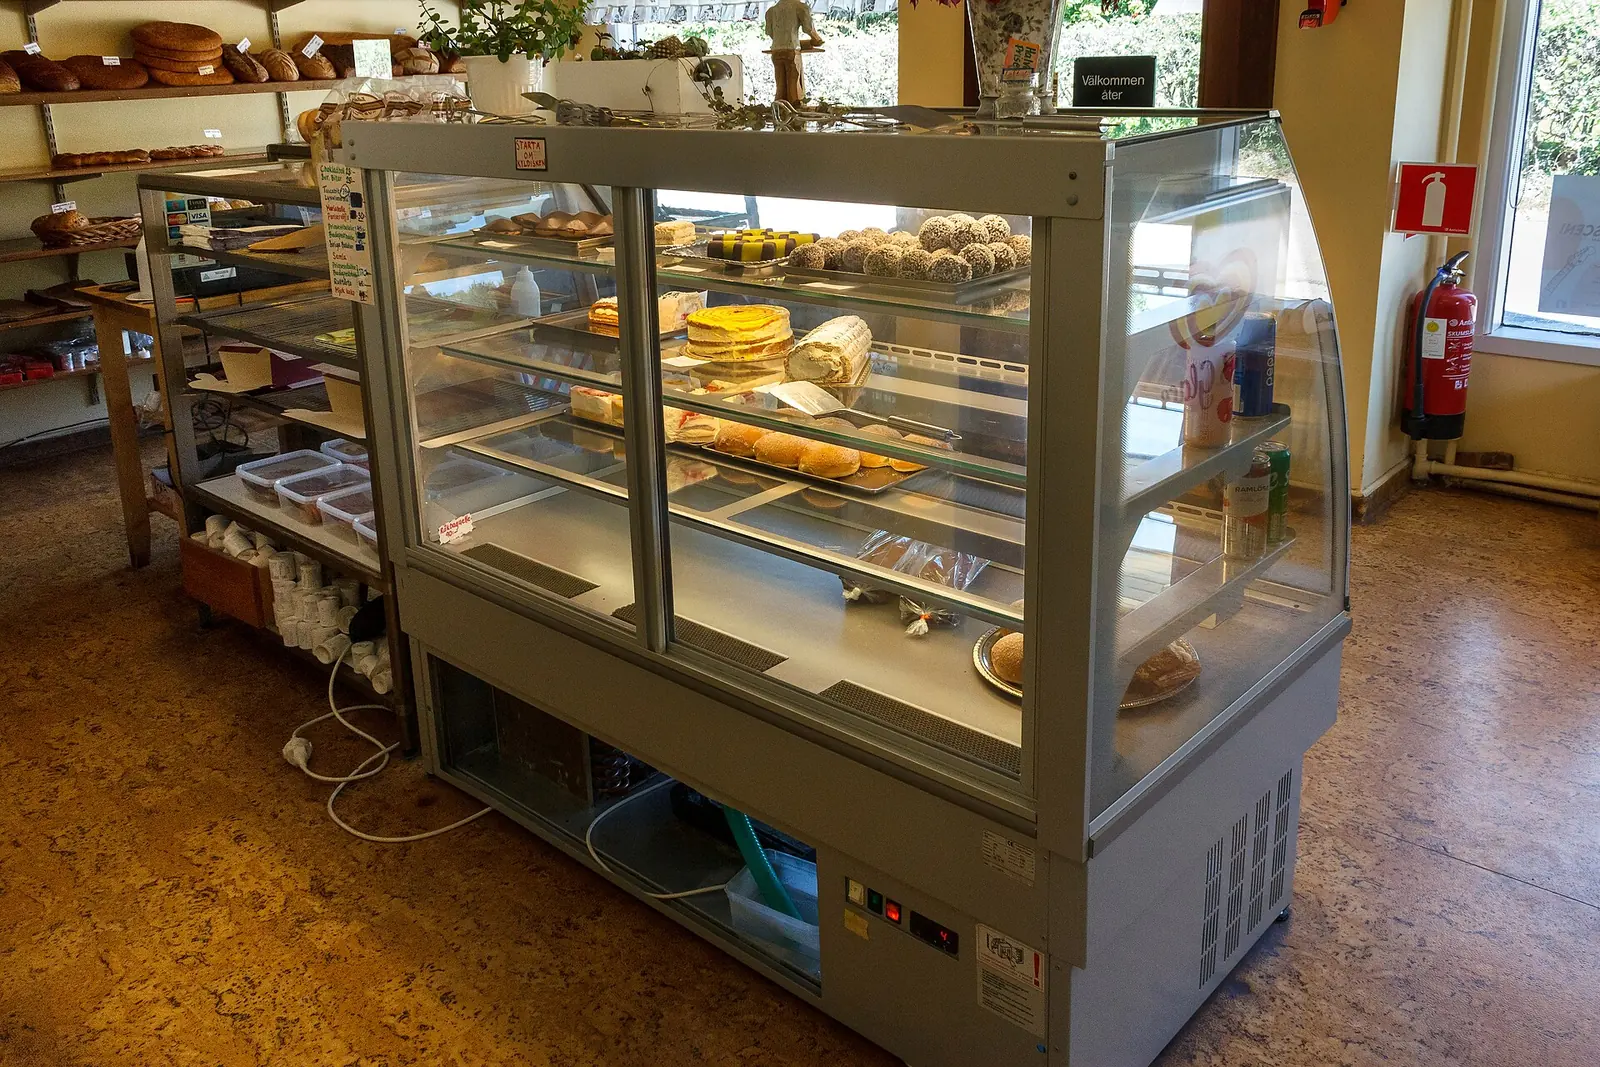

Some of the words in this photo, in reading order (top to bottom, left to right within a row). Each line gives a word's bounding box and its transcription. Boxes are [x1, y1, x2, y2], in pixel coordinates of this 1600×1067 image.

[1081, 74, 1145, 86] Välkommen
[1101, 89, 1123, 100] åter
[516, 140, 541, 151] STARTA
[523, 151, 534, 160] OM
[191, 212, 208, 220] VISA
[1265, 346, 1275, 386] pepsi
[1235, 485, 1269, 493] RAMLÖS
[940, 931, 948, 941] 4
